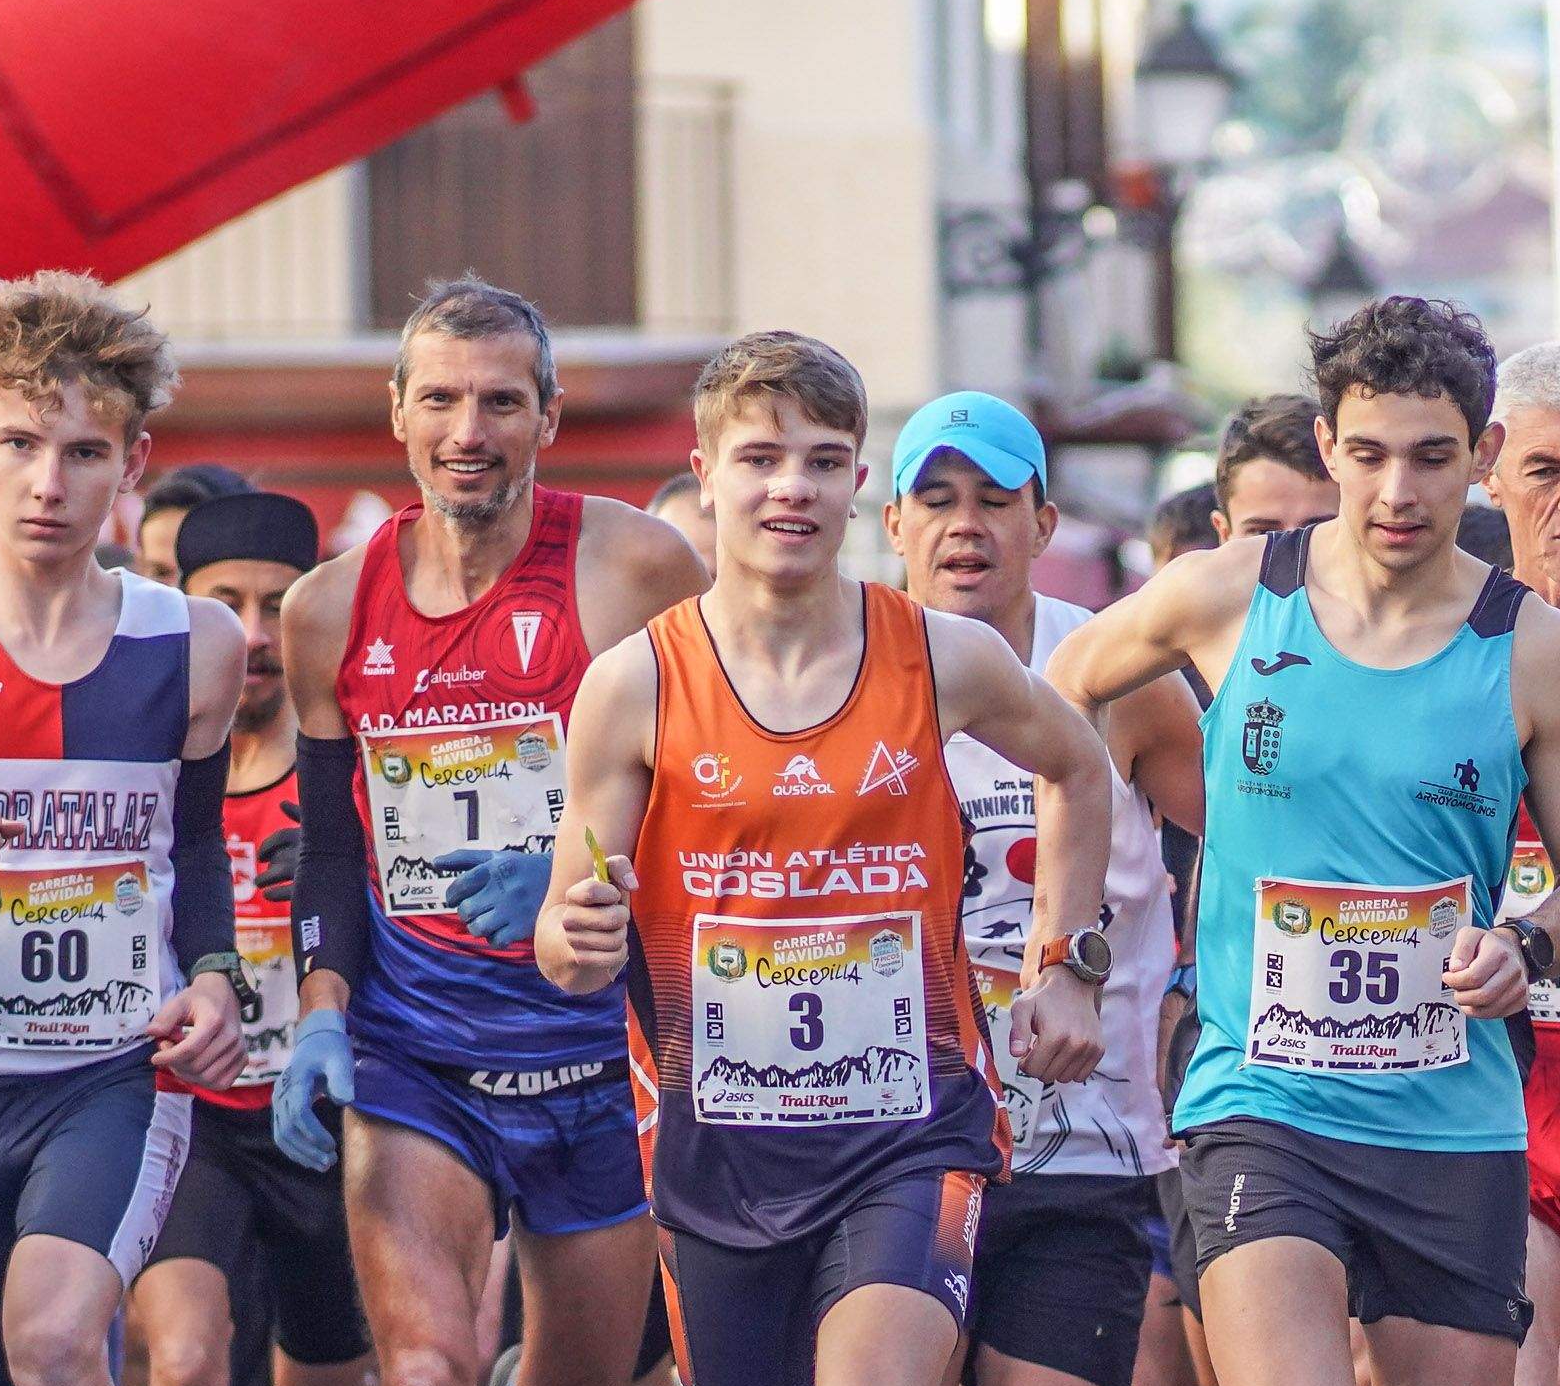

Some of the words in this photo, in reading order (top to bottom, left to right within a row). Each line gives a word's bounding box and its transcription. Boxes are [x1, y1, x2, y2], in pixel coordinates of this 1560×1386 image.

[363, 662, 396, 676] luanvi
[431, 665, 487, 688] alquiber
[360, 712, 398, 732] A.D.
[405, 701, 545, 727] MARATHON
[430, 735, 481, 755] CARRERA
[431, 744, 494, 768] NAVIDAD
[772, 782, 836, 797] austral
[453, 790, 480, 841] 1
[961, 795, 1019, 820] UNNING
[1415, 790, 1496, 818] ARROYOMOLINOS
[678, 847, 773, 870] UNIÓN
[784, 842, 927, 869] ATLÉTICA
[28, 873, 85, 892] CARRERA
[411, 885, 434, 895] asics
[682, 863, 929, 899] COSLADA
[28, 883, 94, 907] NAVIDAD
[1339, 898, 1398, 911] CARRERA
[1338, 908, 1409, 925] NAVIDAD
[773, 931, 835, 950] CARRERA
[21, 929, 90, 983] 60
[774, 942, 846, 966] NAVIDAD
[1328, 949, 1400, 1005] 35
[788, 992, 824, 1051] 3
[1280, 1039, 1306, 1050] asics
[726, 1091, 754, 1102] asics
